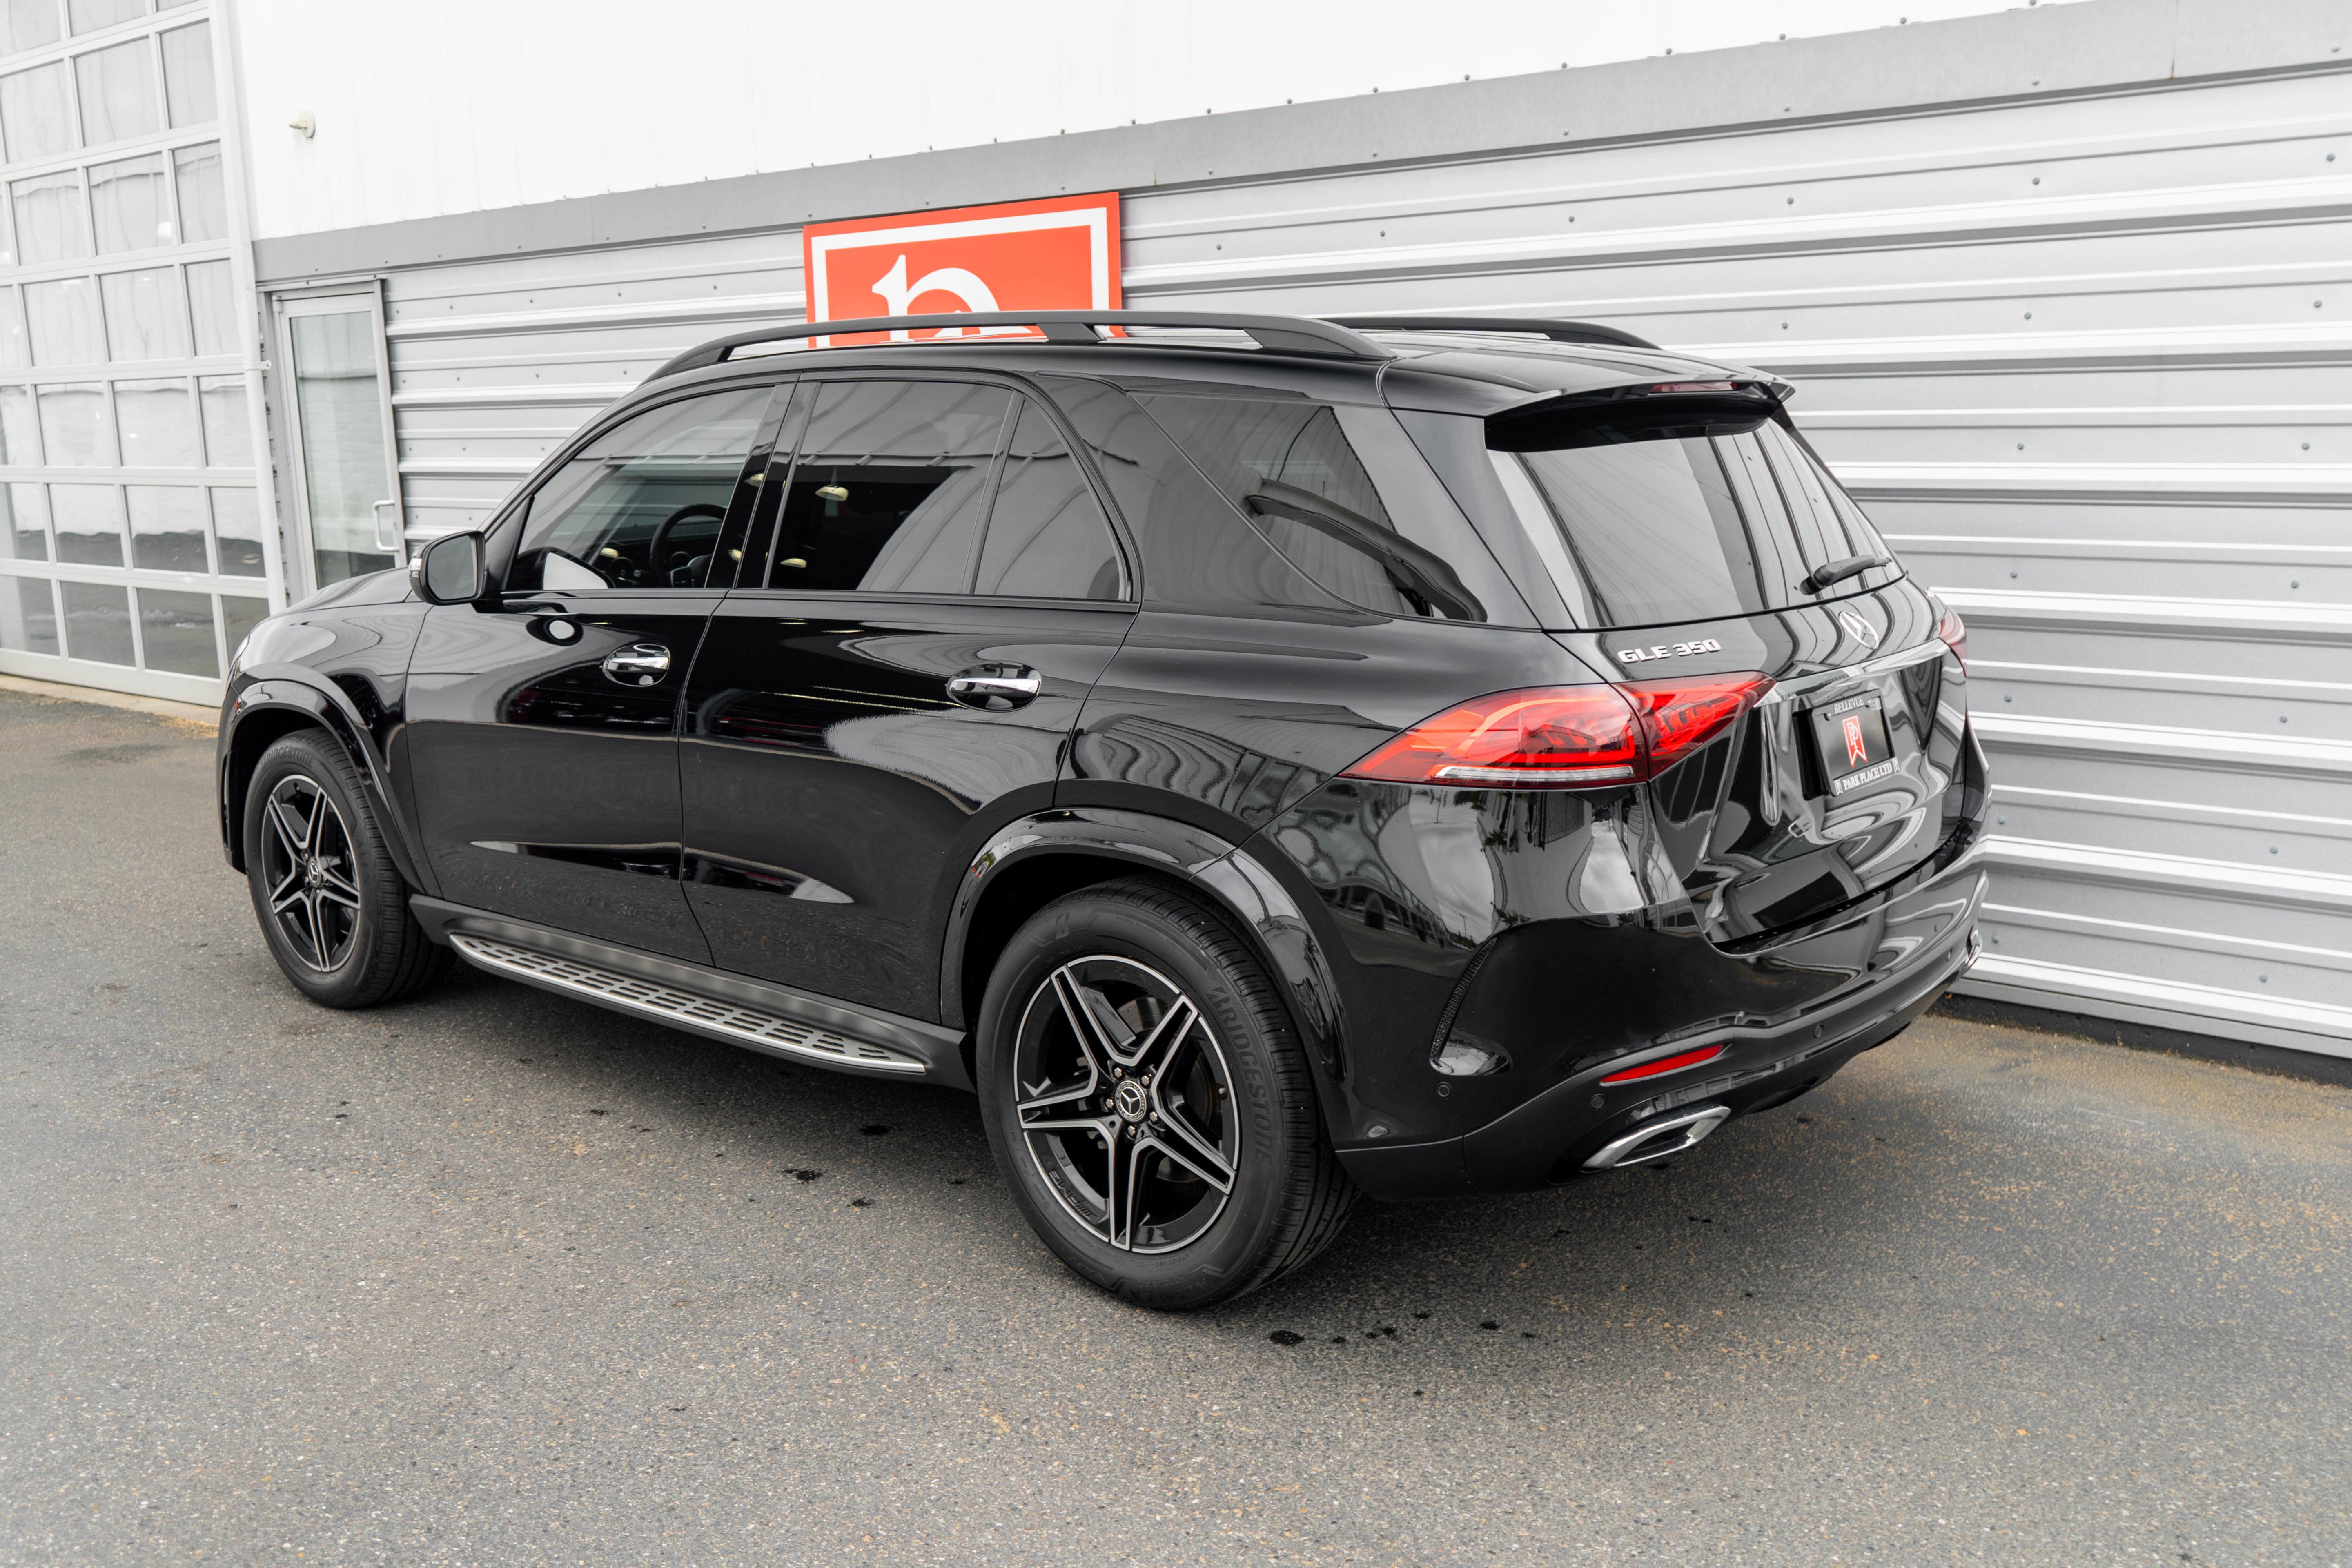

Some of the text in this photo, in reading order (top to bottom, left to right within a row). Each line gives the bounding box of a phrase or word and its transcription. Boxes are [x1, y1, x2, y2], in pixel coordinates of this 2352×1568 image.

[1617, 639, 1721, 663] GLE 350
[1835, 697, 1864, 713] BELLEVUE
[1844, 775, 1860, 790] PARK
[1859, 767, 1880, 784] PLACE
[1878, 762, 1893, 777] LTD
[1205, 985, 1273, 1164] BRIDGESTONE
